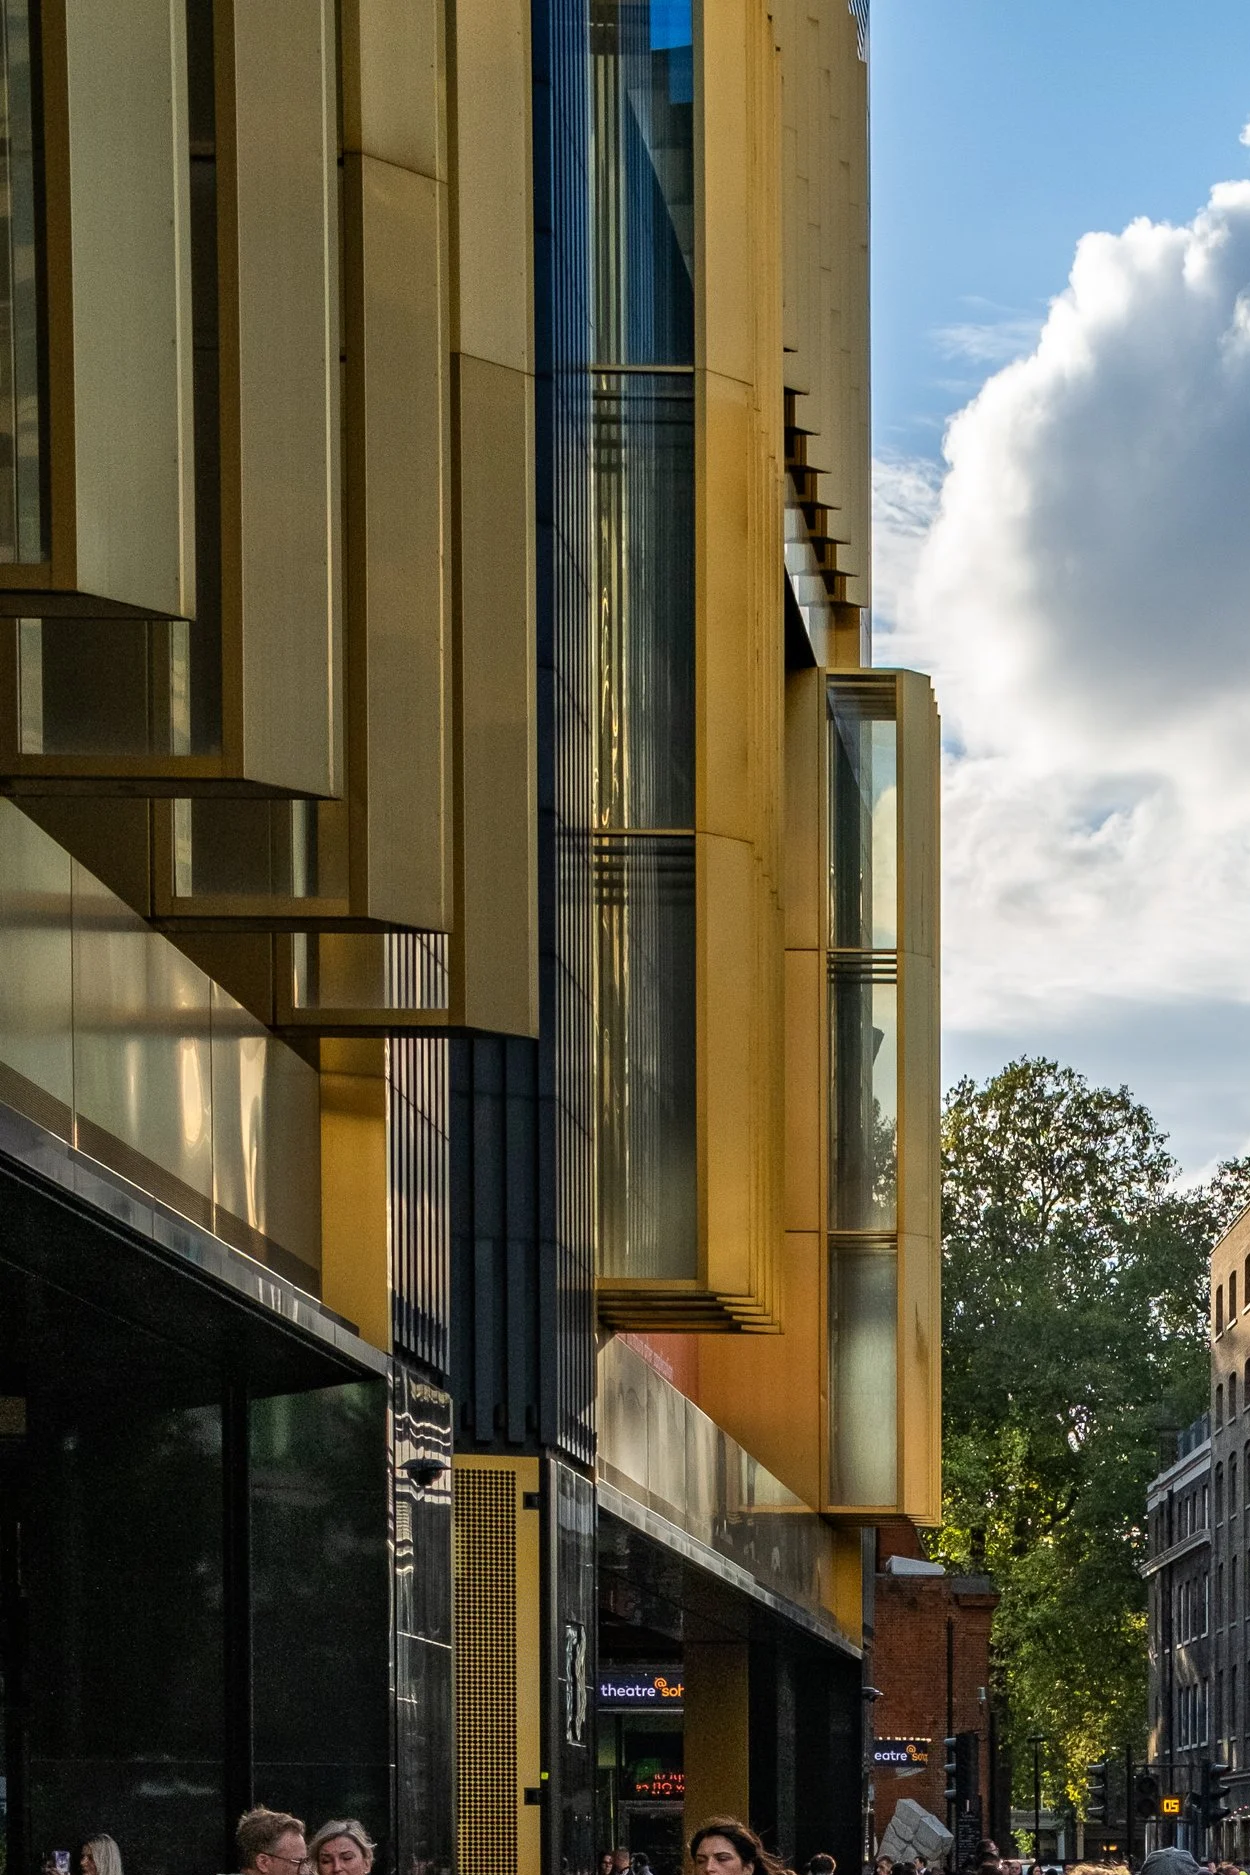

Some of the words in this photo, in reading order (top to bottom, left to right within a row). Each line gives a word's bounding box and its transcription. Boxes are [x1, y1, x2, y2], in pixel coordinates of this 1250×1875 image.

[601, 1683, 656, 1697] theatre
[874, 1750, 908, 1761] eatre
[1164, 1799, 1179, 1812] 05
